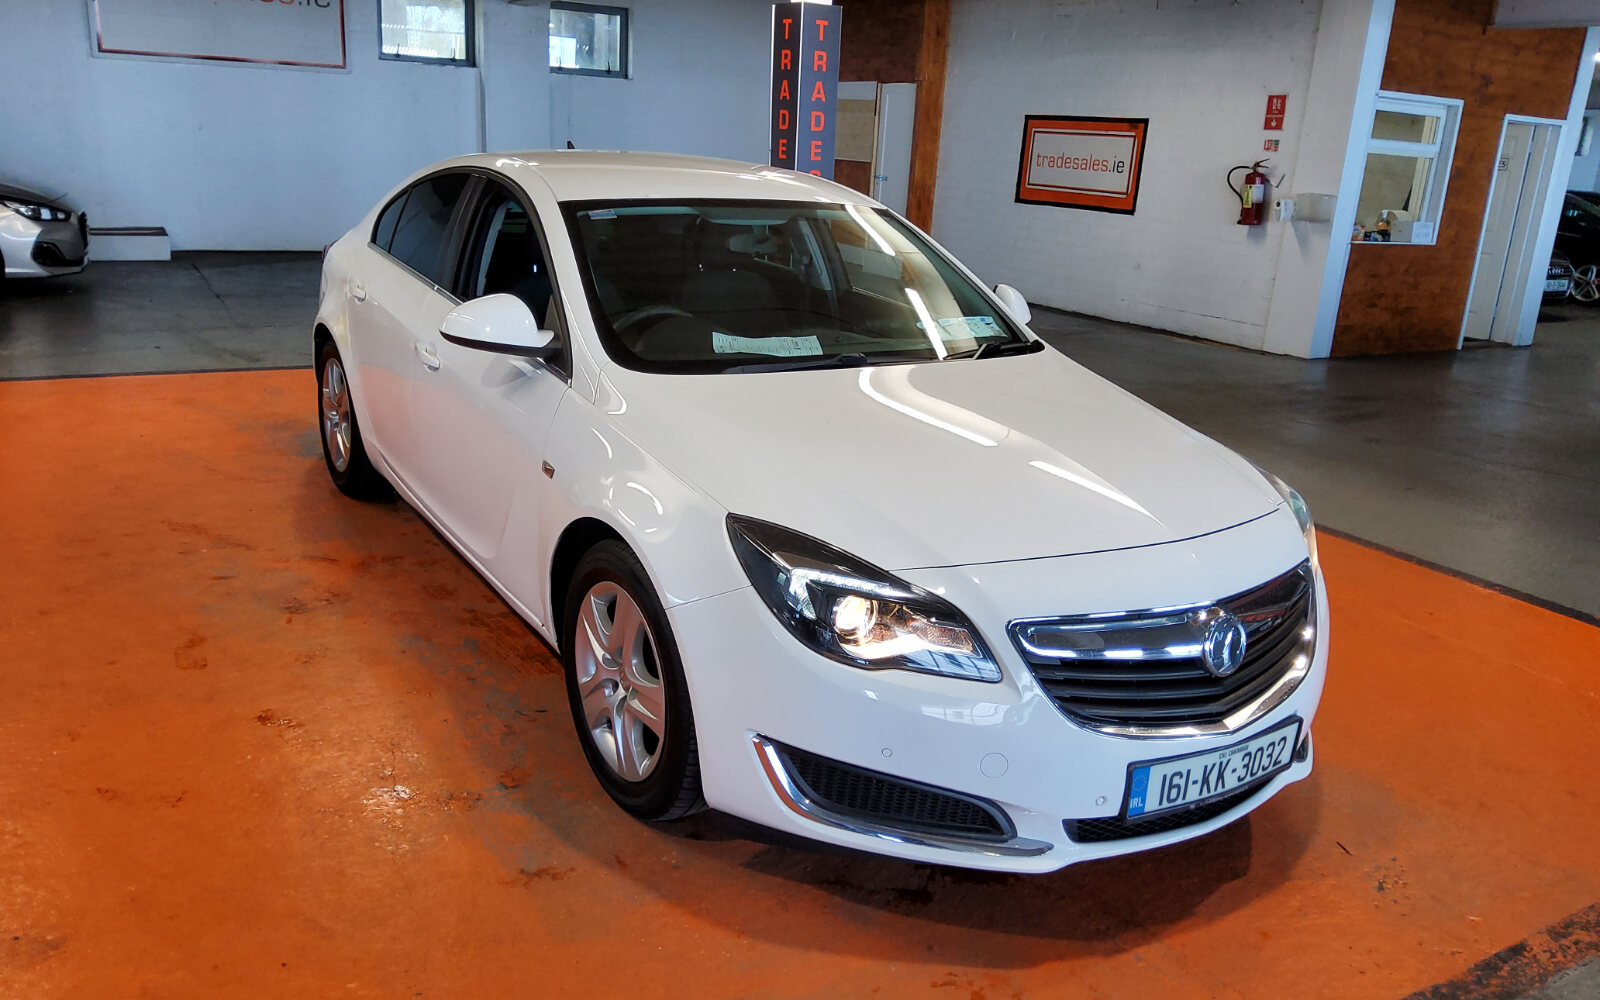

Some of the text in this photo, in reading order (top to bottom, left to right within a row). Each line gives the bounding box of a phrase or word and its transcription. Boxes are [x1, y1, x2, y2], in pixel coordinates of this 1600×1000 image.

[777, 18, 793, 160] TRADE
[1036, 152, 1125, 174] tradesales.ie
[1158, 736, 1288, 806] 161-KK-3032
[1129, 797, 1144, 809] IRL
